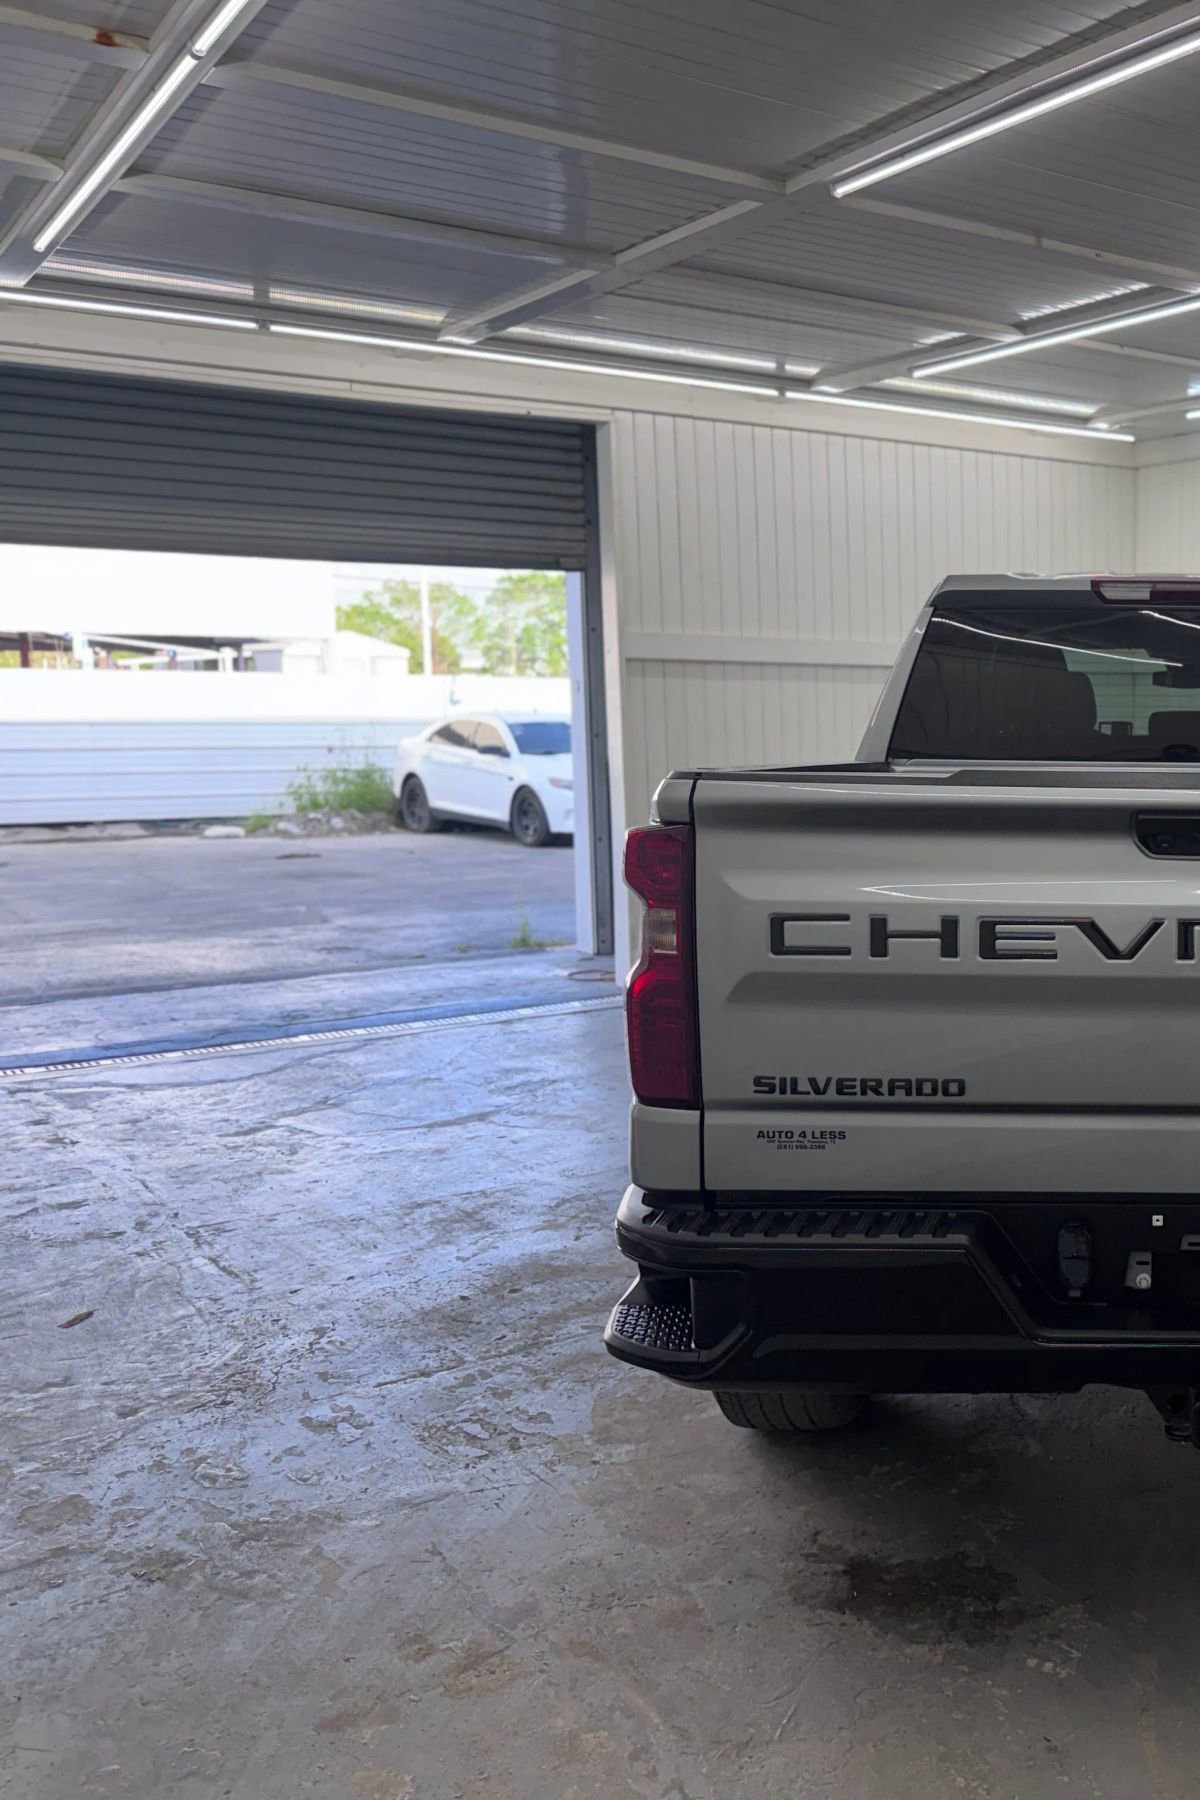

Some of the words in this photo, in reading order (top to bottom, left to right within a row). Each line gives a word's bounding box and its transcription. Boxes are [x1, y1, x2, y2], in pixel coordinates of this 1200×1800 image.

[753, 1075, 966, 1097] SILVERADO
[756, 1130, 794, 1139] AUTO
[798, 1130, 807, 1139] 4
[811, 1130, 846, 1140] LESS
